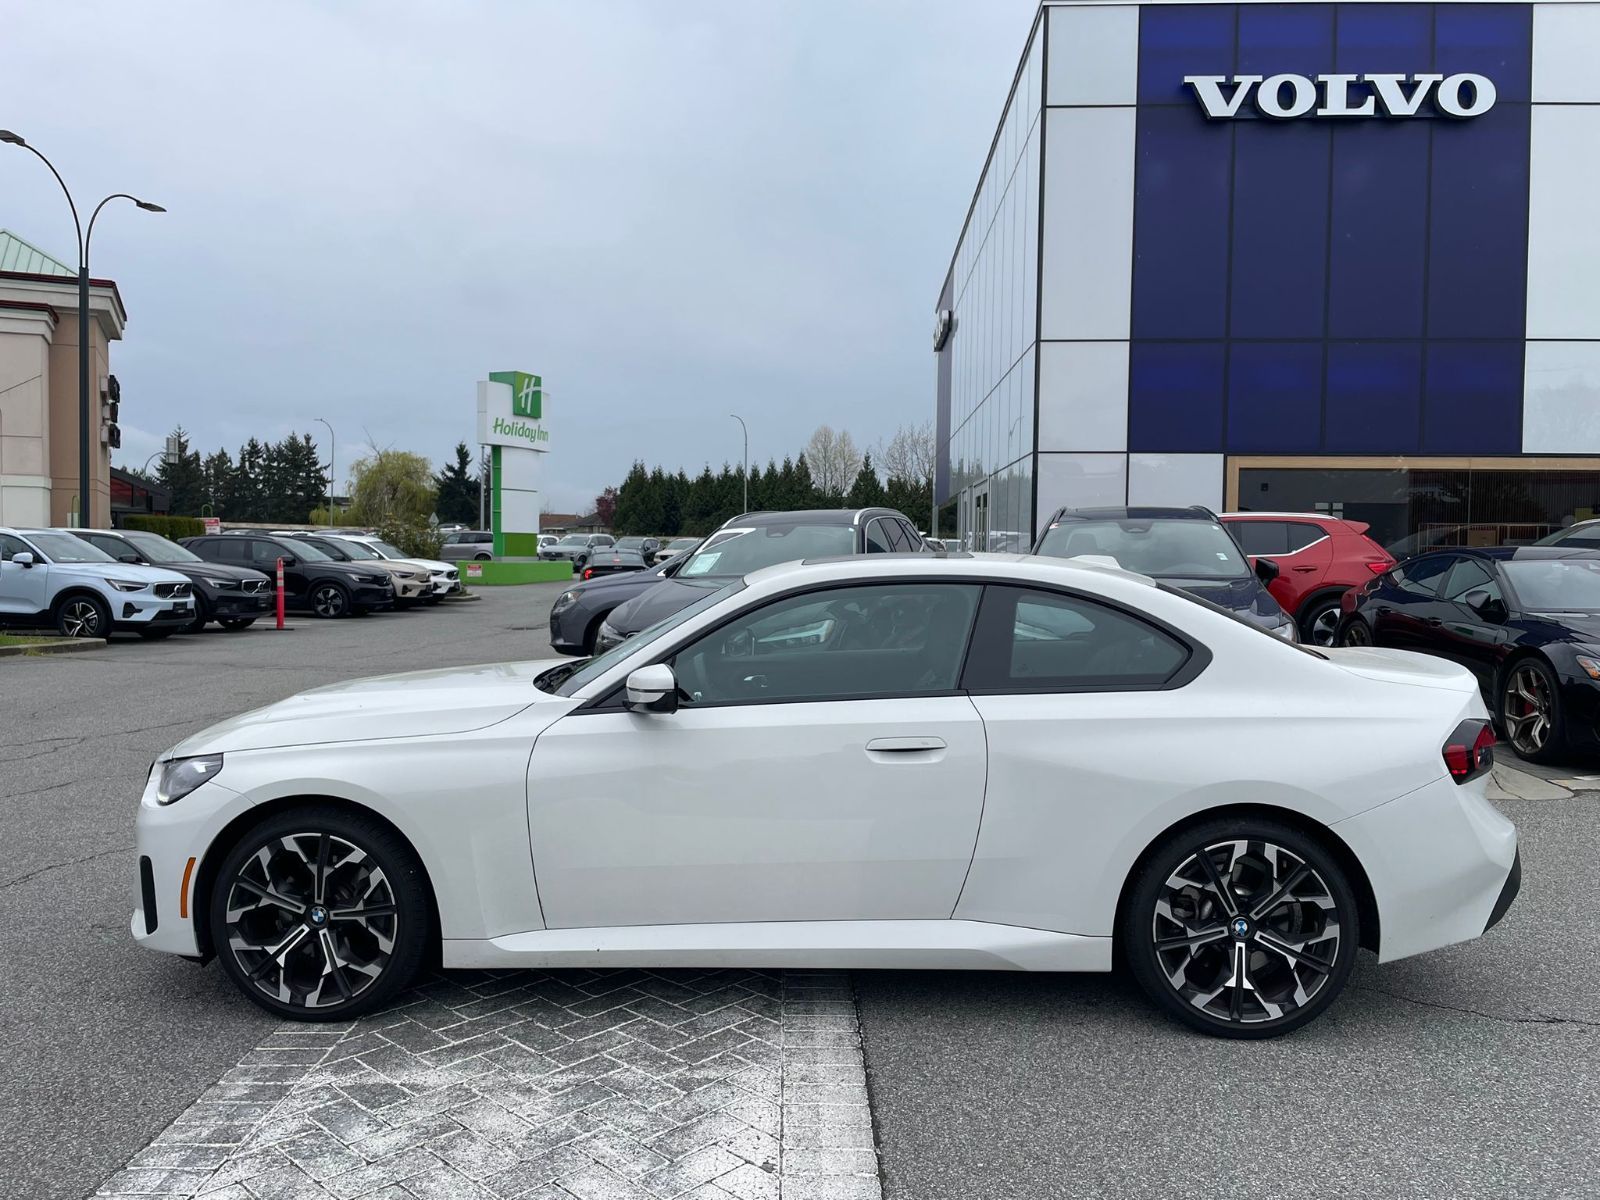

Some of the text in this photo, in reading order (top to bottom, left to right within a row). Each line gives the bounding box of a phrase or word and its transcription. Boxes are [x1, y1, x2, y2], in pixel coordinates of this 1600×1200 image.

[1183, 73, 1497, 117] VOLVO
[493, 417, 549, 442] Holiday Inn
